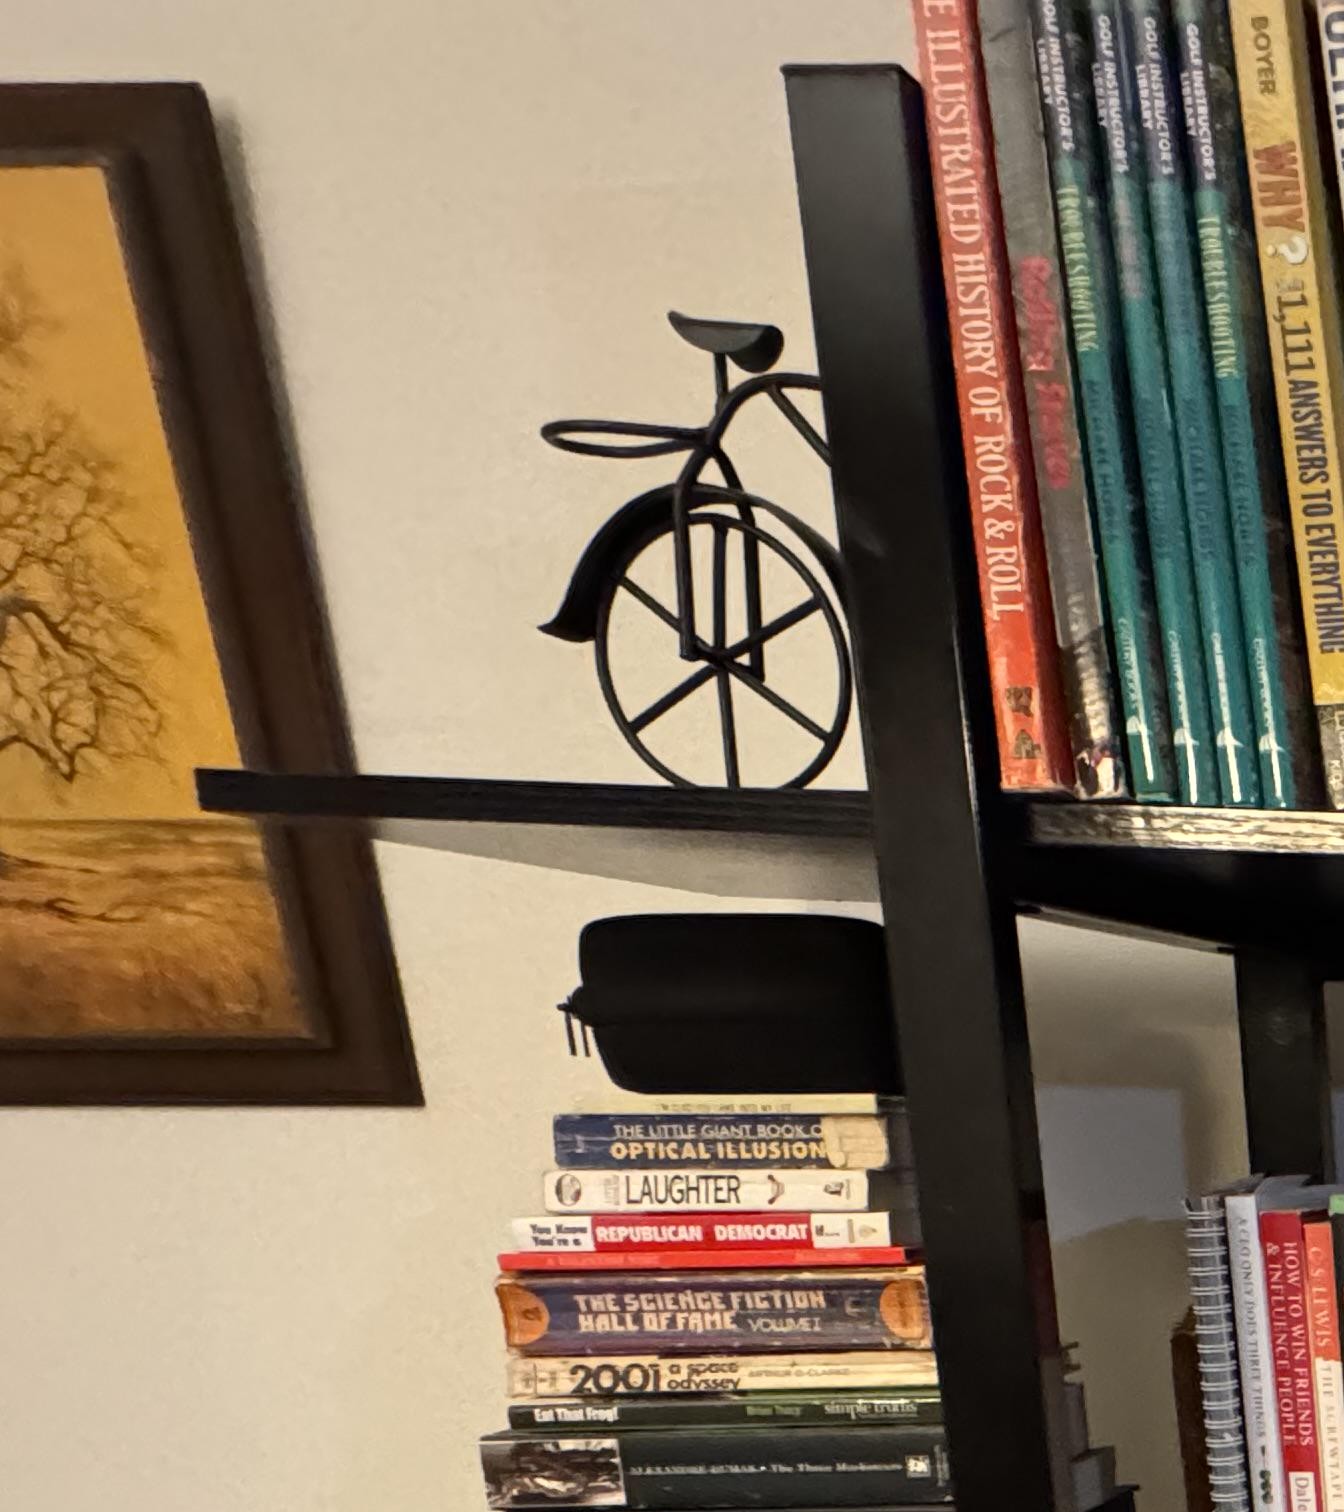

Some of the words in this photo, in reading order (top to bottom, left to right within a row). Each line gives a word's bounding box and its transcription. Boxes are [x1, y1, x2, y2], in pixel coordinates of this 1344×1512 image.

[1251, 16, 1276, 96] BOYER
[926, 30, 980, 245] ILLUSTRATED
[952, 253, 998, 378] HISTORY
[967, 386, 1003, 423] OF
[1287, 380, 1329, 484] ANSWERS
[974, 435, 1013, 513] ROCK
[1302, 489, 1334, 518] TO
[984, 519, 1014, 540] &
[985, 545, 1024, 621] ROLL
[610, 1143, 711, 1161] OPTICAL
[625, 1175, 741, 1205] LAUGHTER
[596, 1225, 704, 1243] REPUBLICAN
[714, 1224, 808, 1241] DEMOCRAT
[1267, 1242, 1279, 1255] &
[1283, 1242, 1299, 1285] HOW
[1268, 1264, 1289, 1370] INFLUENCE
[1288, 1295, 1303, 1318] TO
[1291, 1324, 1307, 1366] WIN
[569, 1363, 661, 1394] 2001
[1278, 1377, 1295, 1442] PEOPLE
[1294, 1370, 1313, 1446] FRIENDS
